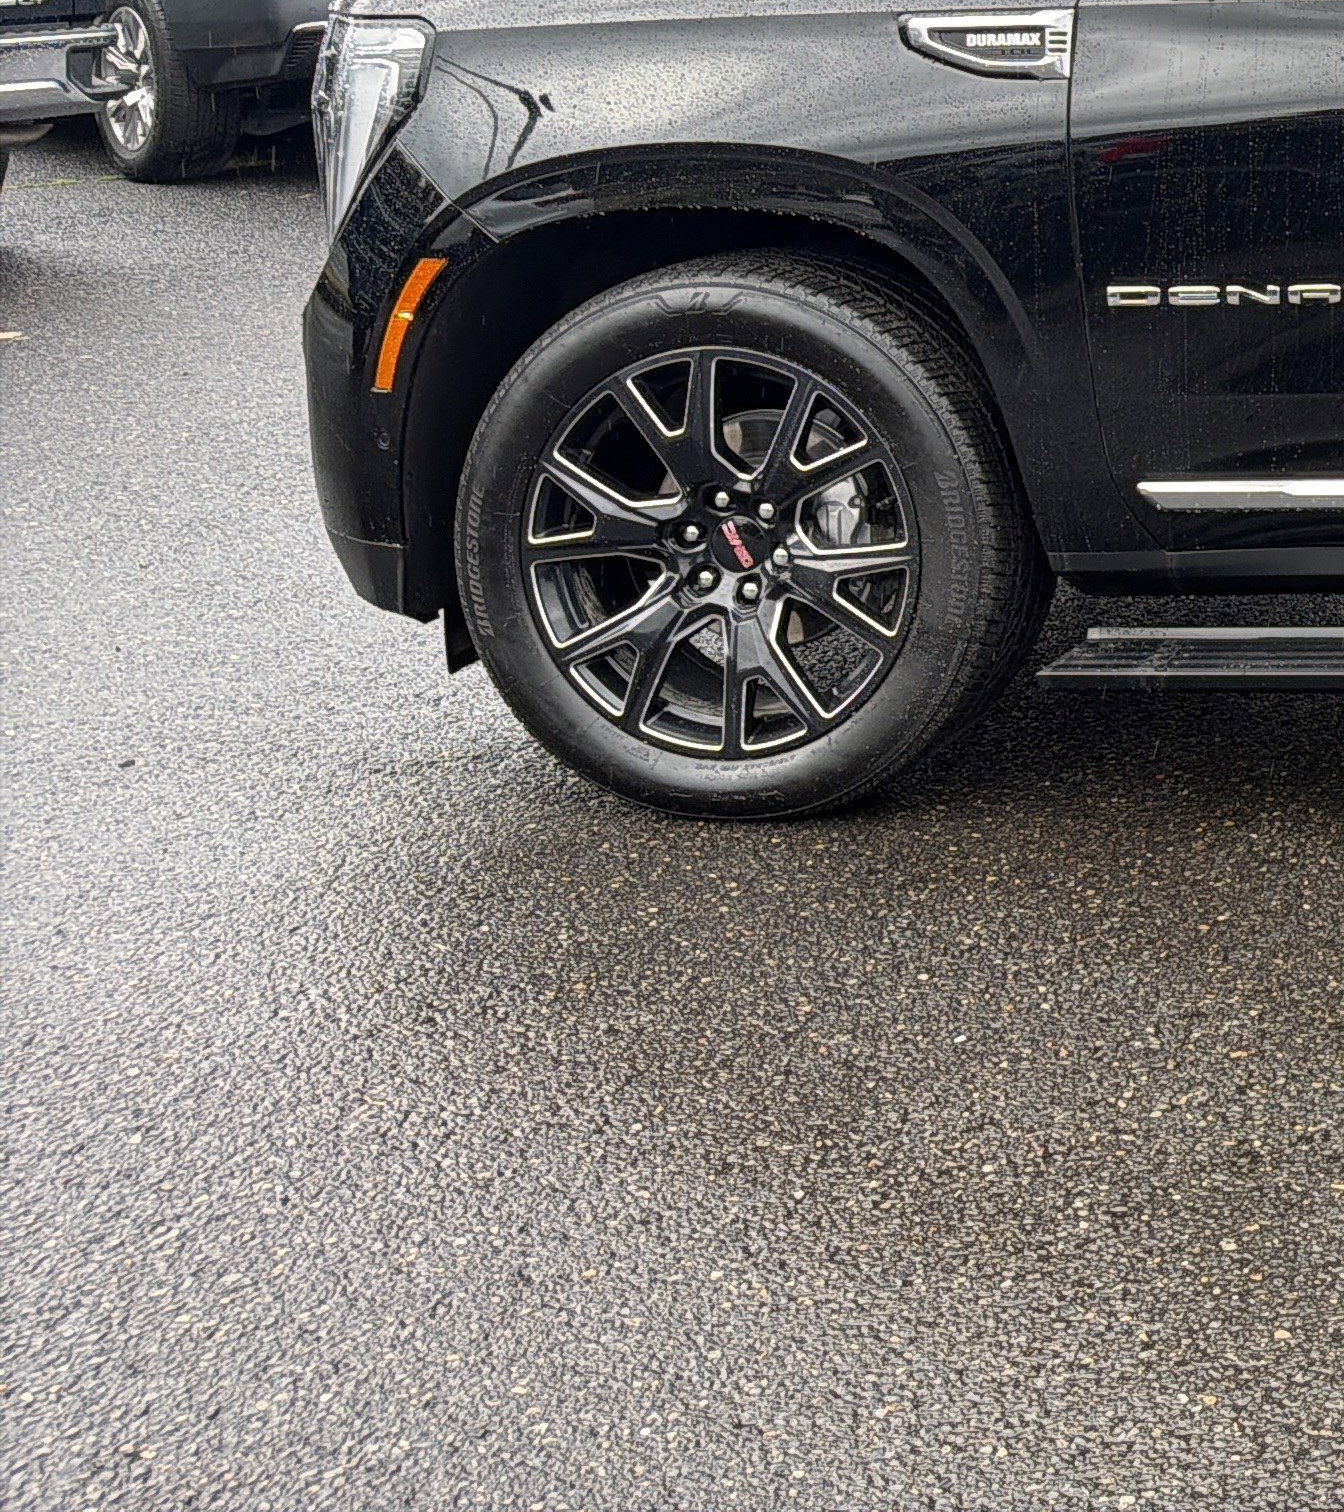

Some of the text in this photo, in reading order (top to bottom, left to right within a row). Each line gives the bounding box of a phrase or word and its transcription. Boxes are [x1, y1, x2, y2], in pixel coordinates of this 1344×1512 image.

[966, 32, 1041, 47] DURAMAX
[465, 486, 496, 638] BRIDGESTONE
[721, 520, 754, 568] GMC
